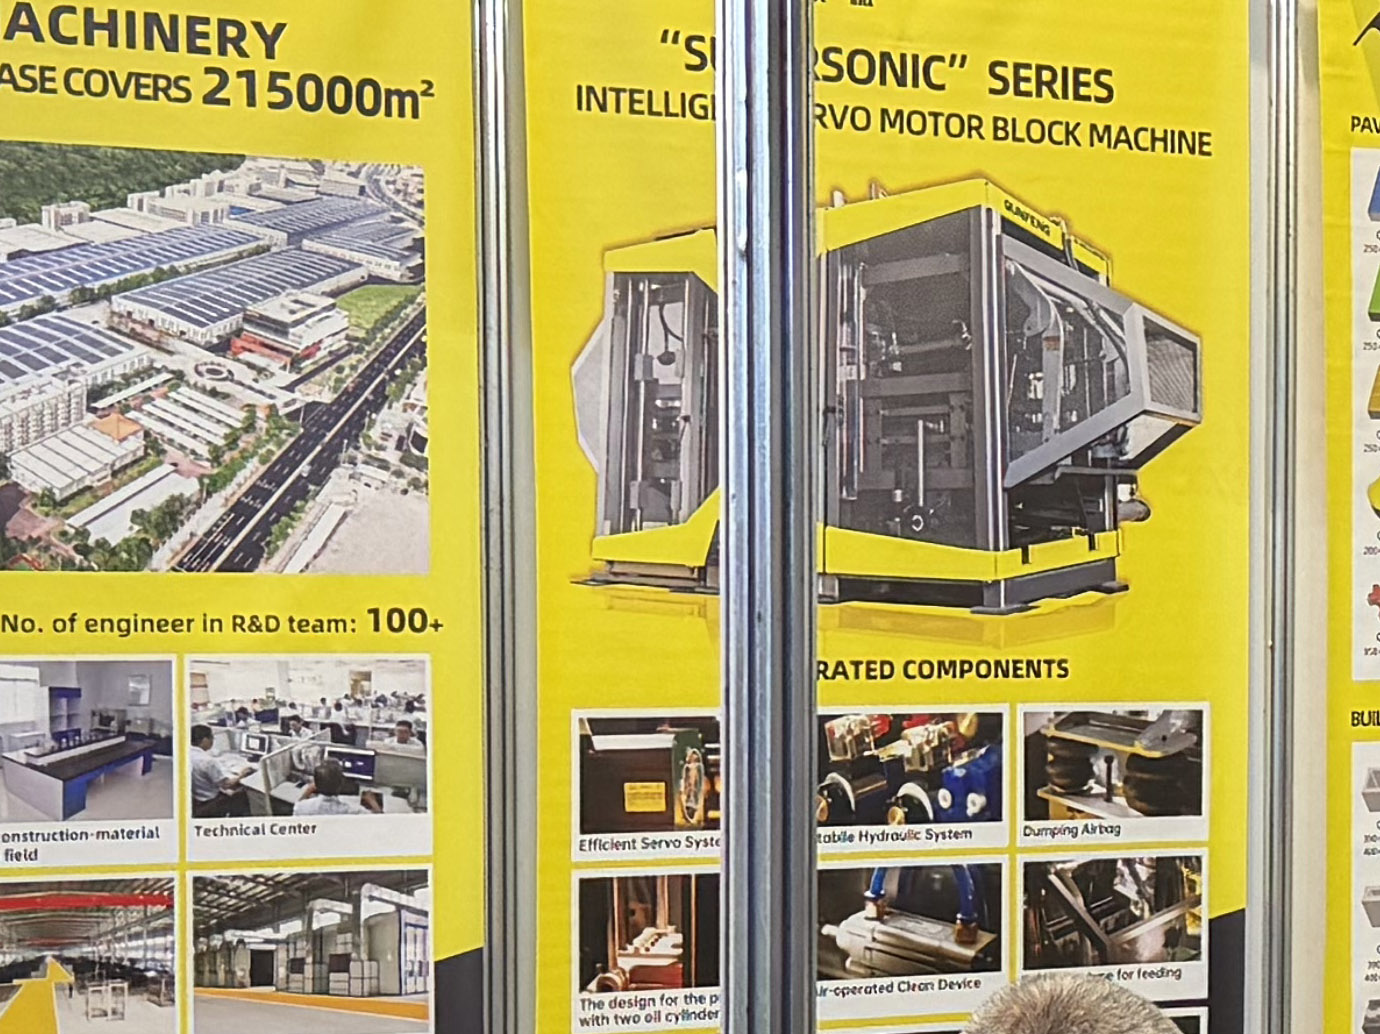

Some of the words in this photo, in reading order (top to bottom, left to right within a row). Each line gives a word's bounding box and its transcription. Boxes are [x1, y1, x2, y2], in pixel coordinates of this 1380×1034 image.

[4, 2, 287, 59] ACHINERY
[63, 67, 192, 102] COVERS
[988, 61, 1115, 104] SERIES
[577, 84, 717, 120] INTELLIG
[880, 108, 985, 141] MOTOR
[993, 117, 1081, 147] BLOCK
[1088, 127, 1212, 156] MACHINE
[1, 614, 43, 633] No.
[53, 612, 77, 633] of
[85, 613, 194, 638] engineer
[202, 614, 223, 632] in
[232, 615, 280, 633] R&D
[288, 615, 356, 633] team:
[367, 608, 443, 634] 100+
[903, 658, 1070, 679] COMPONENTS
[2, 826, 159, 843] onstruction-material
[195, 823, 266, 837] Technical
[270, 822, 316, 836] Center
[859, 829, 920, 844] Hydraulic
[925, 828, 972, 842] System
[1022, 824, 1079, 840] Dumping
[1082, 820, 1122, 838] Airbag
[579, 838, 636, 851] Efficient
[641, 837, 681, 849] Servo
[5, 848, 38, 861] field
[1118, 968, 1134, 980] for
[1138, 967, 1181, 980] feeding
[816, 982, 893, 998] ir-operated
[898, 982, 934, 992] Clean
[939, 979, 981, 990] Device
[581, 998, 604, 1010] The
[608, 996, 656, 1010] design
[660, 994, 678, 1006] for
[684, 993, 706, 1004] the
[580, 1014, 609, 1026] with
[614, 1014, 640, 1024] two
[645, 1011, 660, 1022] oil
